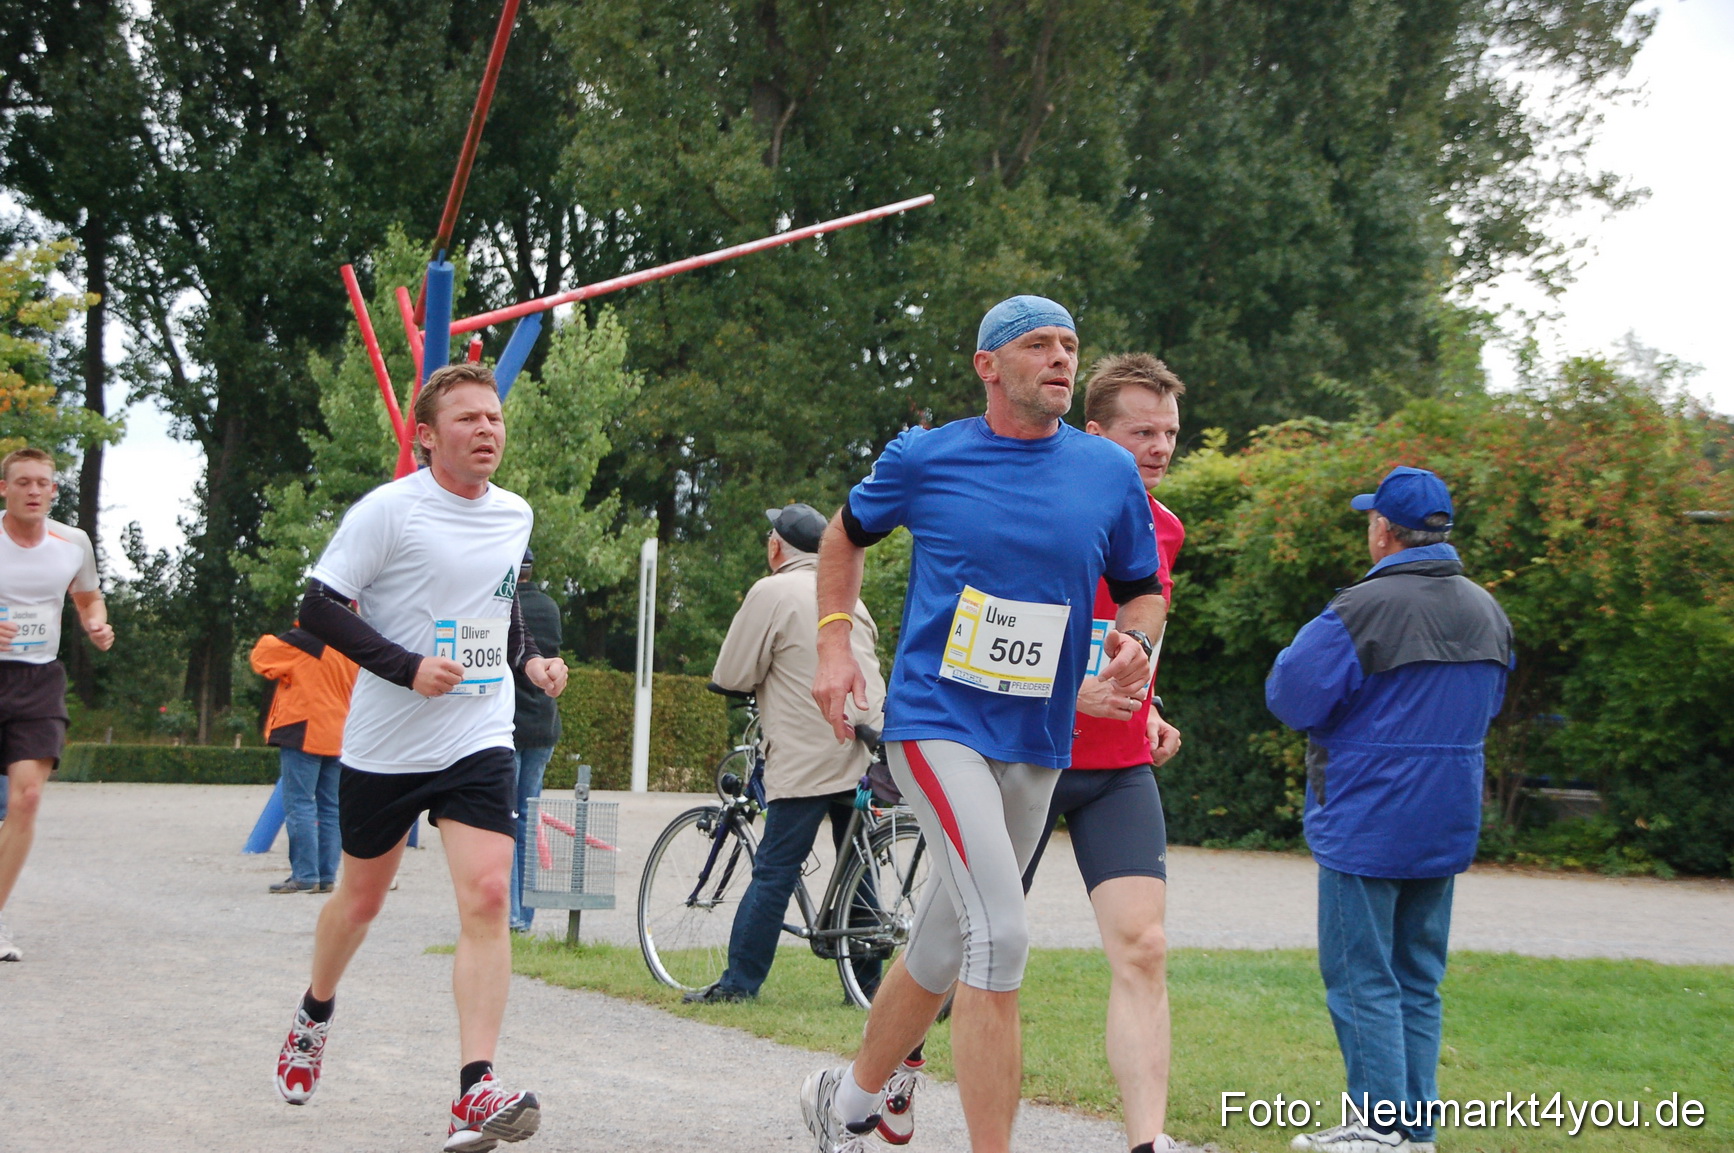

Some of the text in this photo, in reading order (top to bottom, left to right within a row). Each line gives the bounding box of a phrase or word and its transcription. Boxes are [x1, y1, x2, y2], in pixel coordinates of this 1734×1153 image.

[986, 606, 1017, 628] Uwe
[461, 625, 490, 639] Oliver
[955, 623, 962, 637] A
[462, 647, 502, 668] 3096
[989, 637, 1043, 666] 505
[1011, 681, 1051, 691] PFLEIDERER
